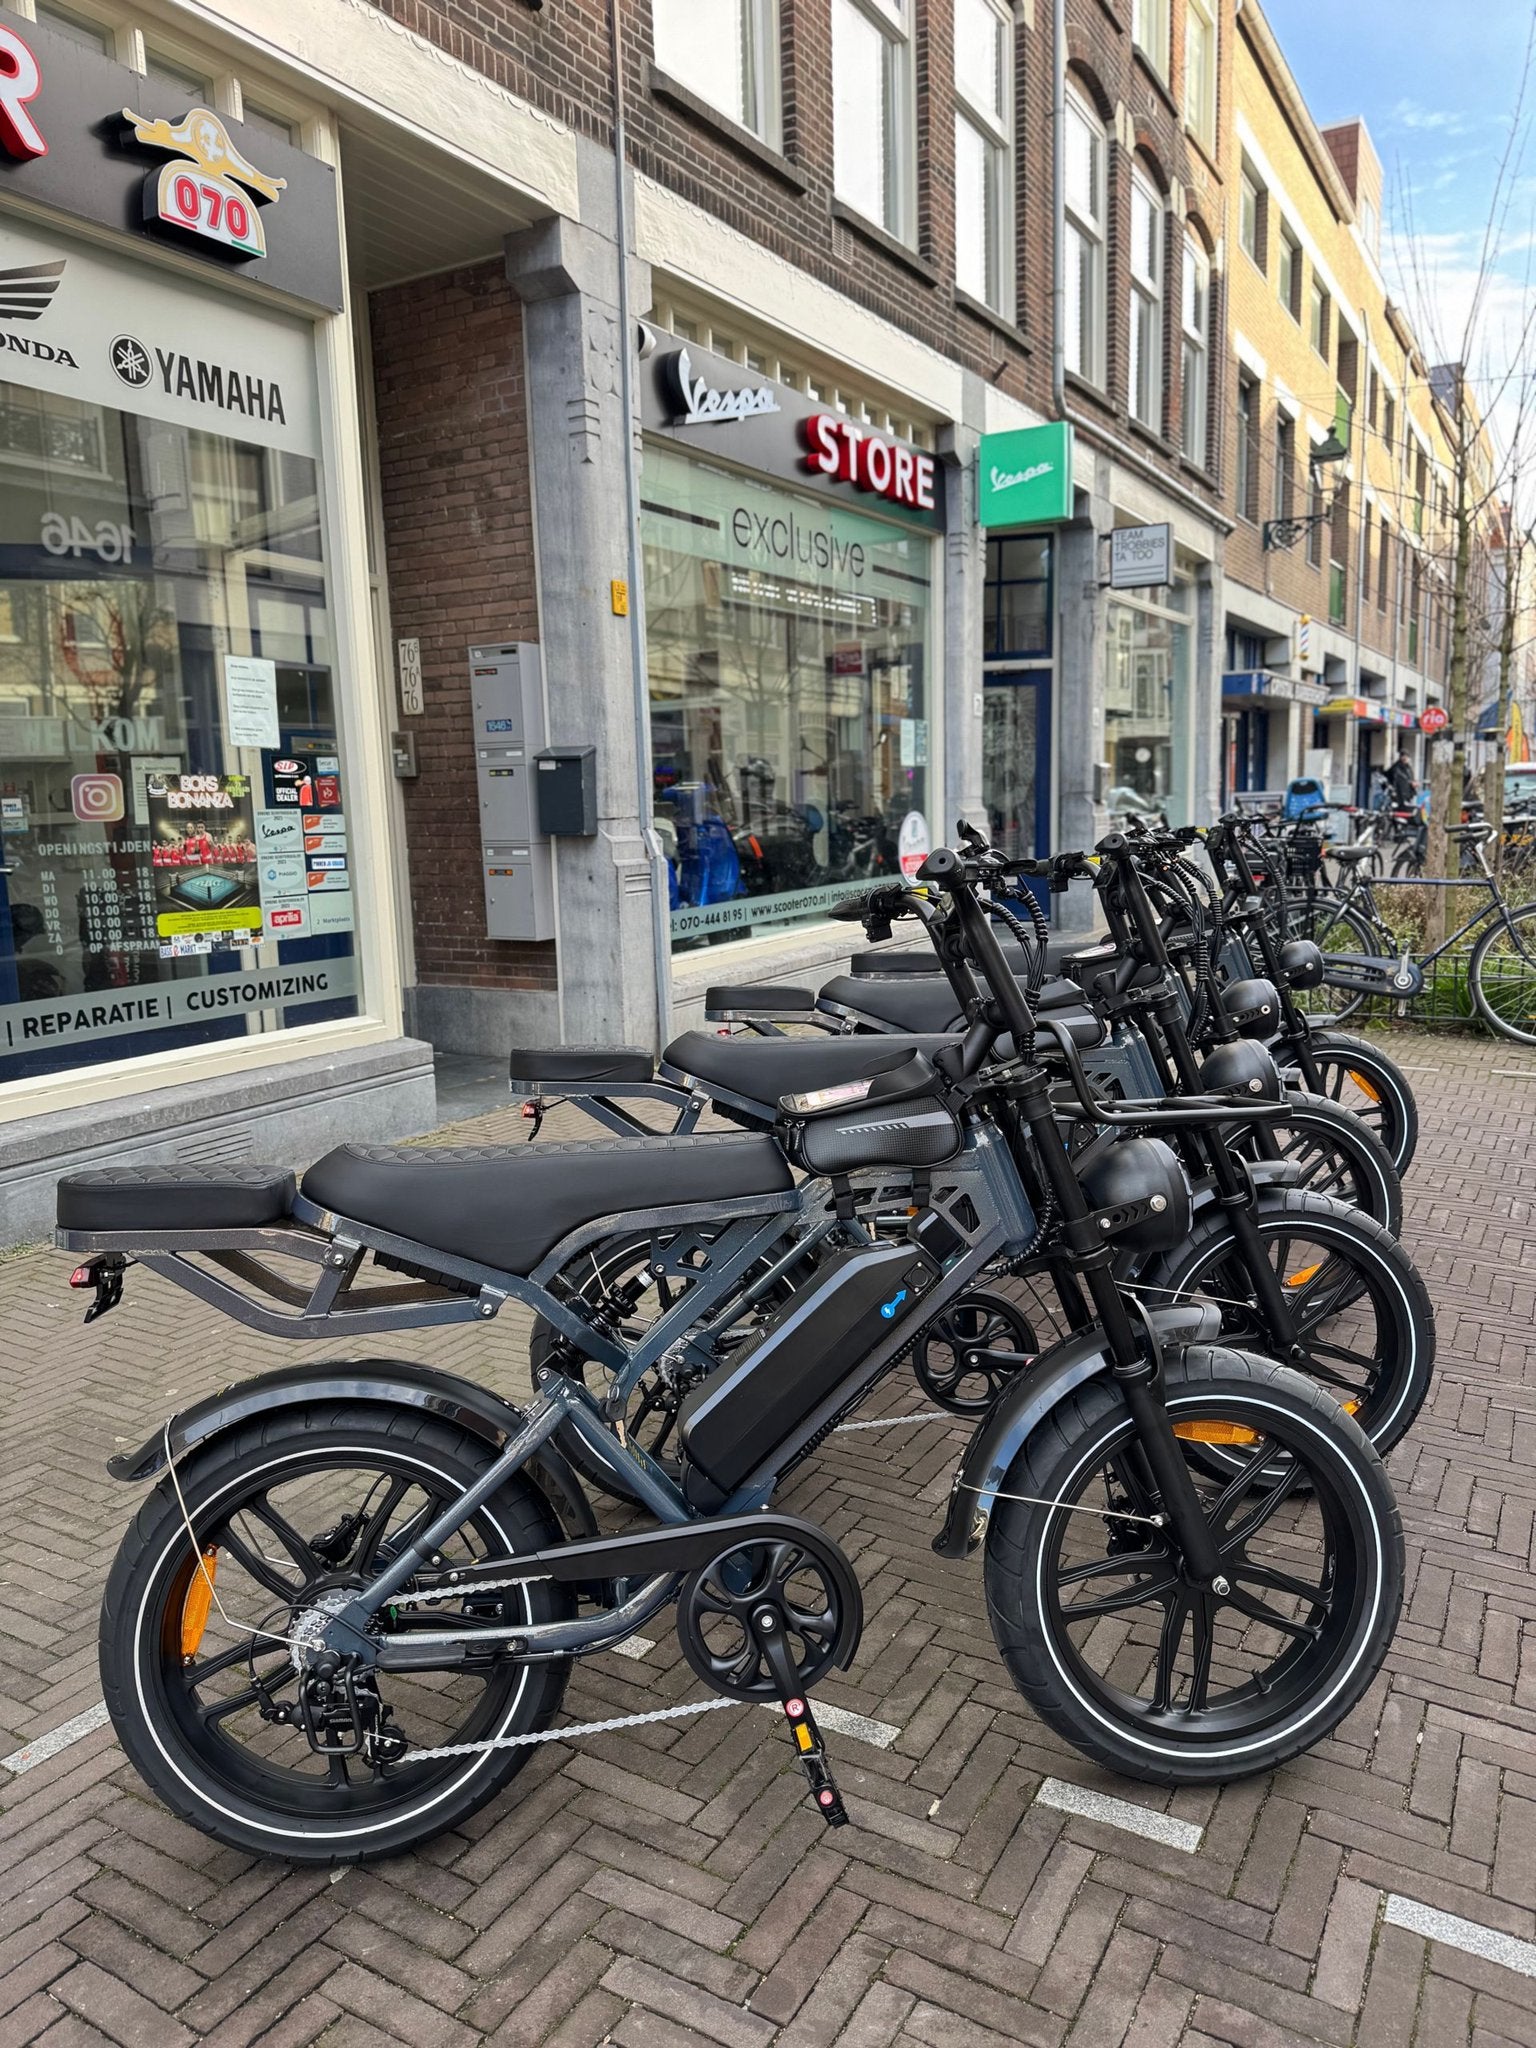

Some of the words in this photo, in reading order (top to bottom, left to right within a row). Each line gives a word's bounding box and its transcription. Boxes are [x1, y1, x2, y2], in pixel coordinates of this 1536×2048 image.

[174, 175, 249, 240] 070
[0, 332, 80, 369] NDA
[155, 347, 287, 425] YAMAHA
[677, 347, 781, 425] Vespa
[813, 413, 935, 510] STORE
[991, 462, 1054, 493] Vespa
[732, 507, 865, 578] exclusive
[1115, 529, 1144, 541] TEAM
[1115, 552, 1127, 562] TA
[1131, 548, 1154, 561] TOO
[403, 689, 419, 711] 76
[167, 791, 234, 809] BONANZA
[262, 824, 295, 839] Vespa
[38, 841, 152, 856] OPENINGSTIJDEN
[41, 871, 56, 882] MA
[82, 868, 116, 880] 11.00
[136, 866, 154, 877] 18.
[42, 883, 55, 894] DI
[83, 881, 118, 892] 10.00
[137, 879, 155, 889] 18.
[43, 896, 58, 906] WO
[84, 893, 119, 904] 10.00
[138, 891, 156, 901] 18.
[45, 908, 59, 919] DO
[85, 905, 120, 917] 10.00
[139, 904, 158, 914] 21.
[273, 912, 299, 926] aprilia
[680, 912, 720, 931] 070-444
[722, 909, 731, 923] 81
[732, 907, 743, 920] 95
[751, 892, 827, 918] www.scooter070.nl
[46, 920, 61, 931] VR
[87, 917, 121, 928] 10.00
[48, 933, 63, 944] ZA
[88, 930, 122, 941] 10.00
[90, 942, 103, 954] OP
[22, 997, 159, 1040] REPARATIE
[186, 972, 329, 1012] CUSTOMIZING
